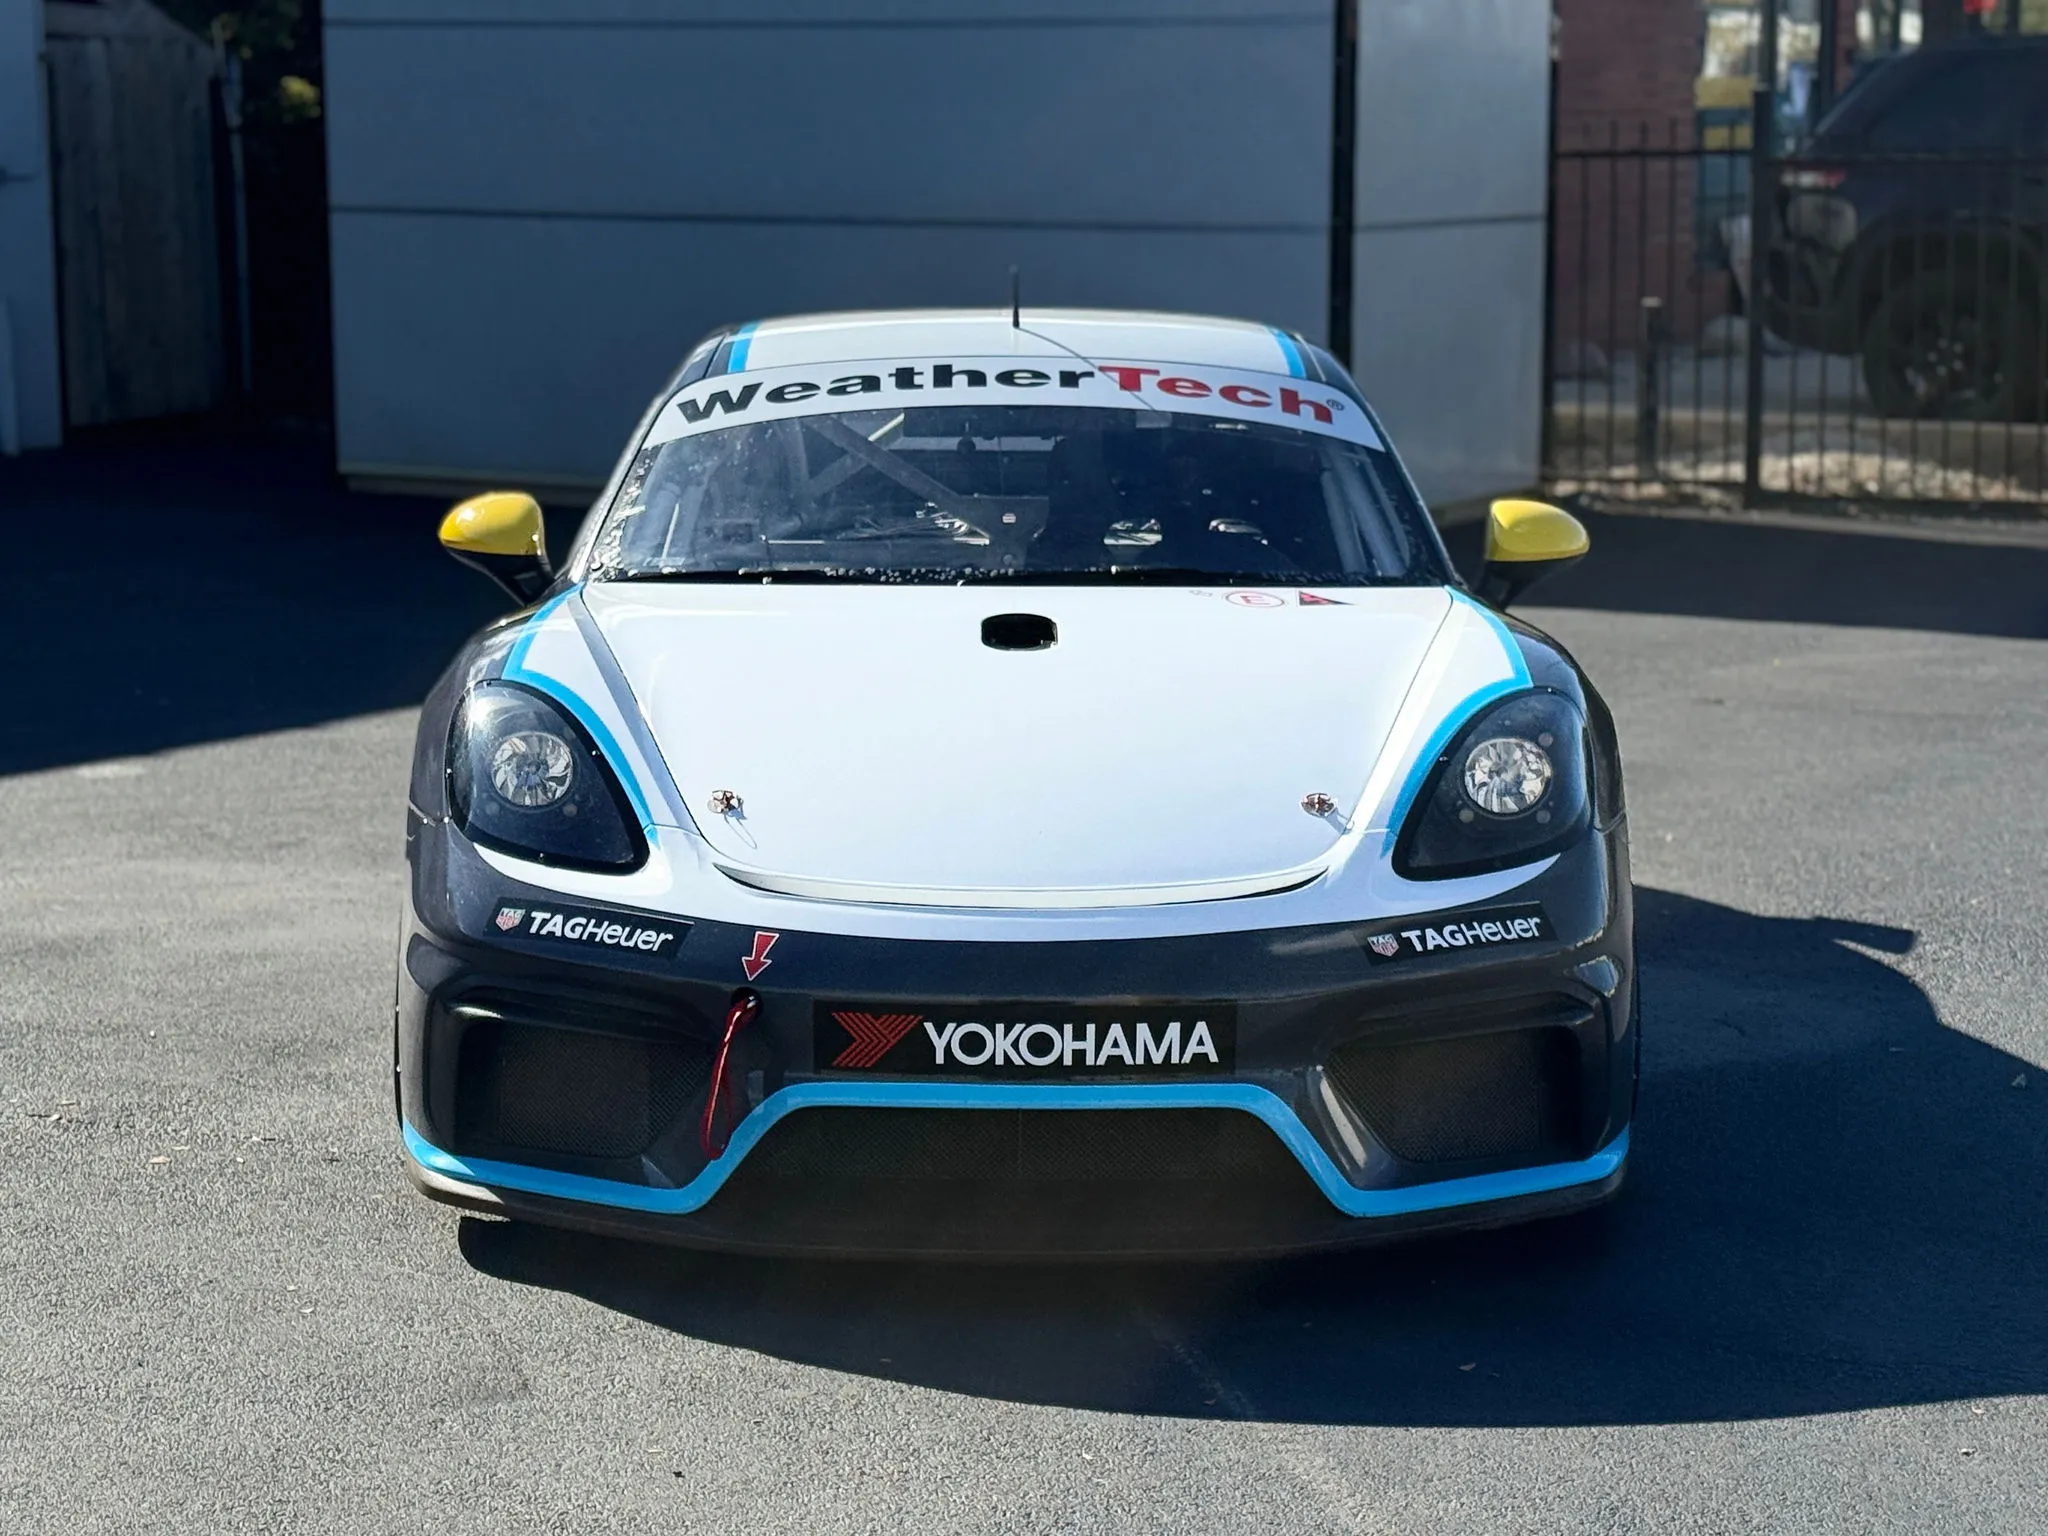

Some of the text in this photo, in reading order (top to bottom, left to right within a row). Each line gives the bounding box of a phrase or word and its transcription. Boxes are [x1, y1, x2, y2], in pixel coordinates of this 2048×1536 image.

[529, 911, 674, 951] TAGHeuer
[1401, 916, 1541, 952] TAGHeuer
[923, 1021, 1219, 1066] YOKOHAMA
